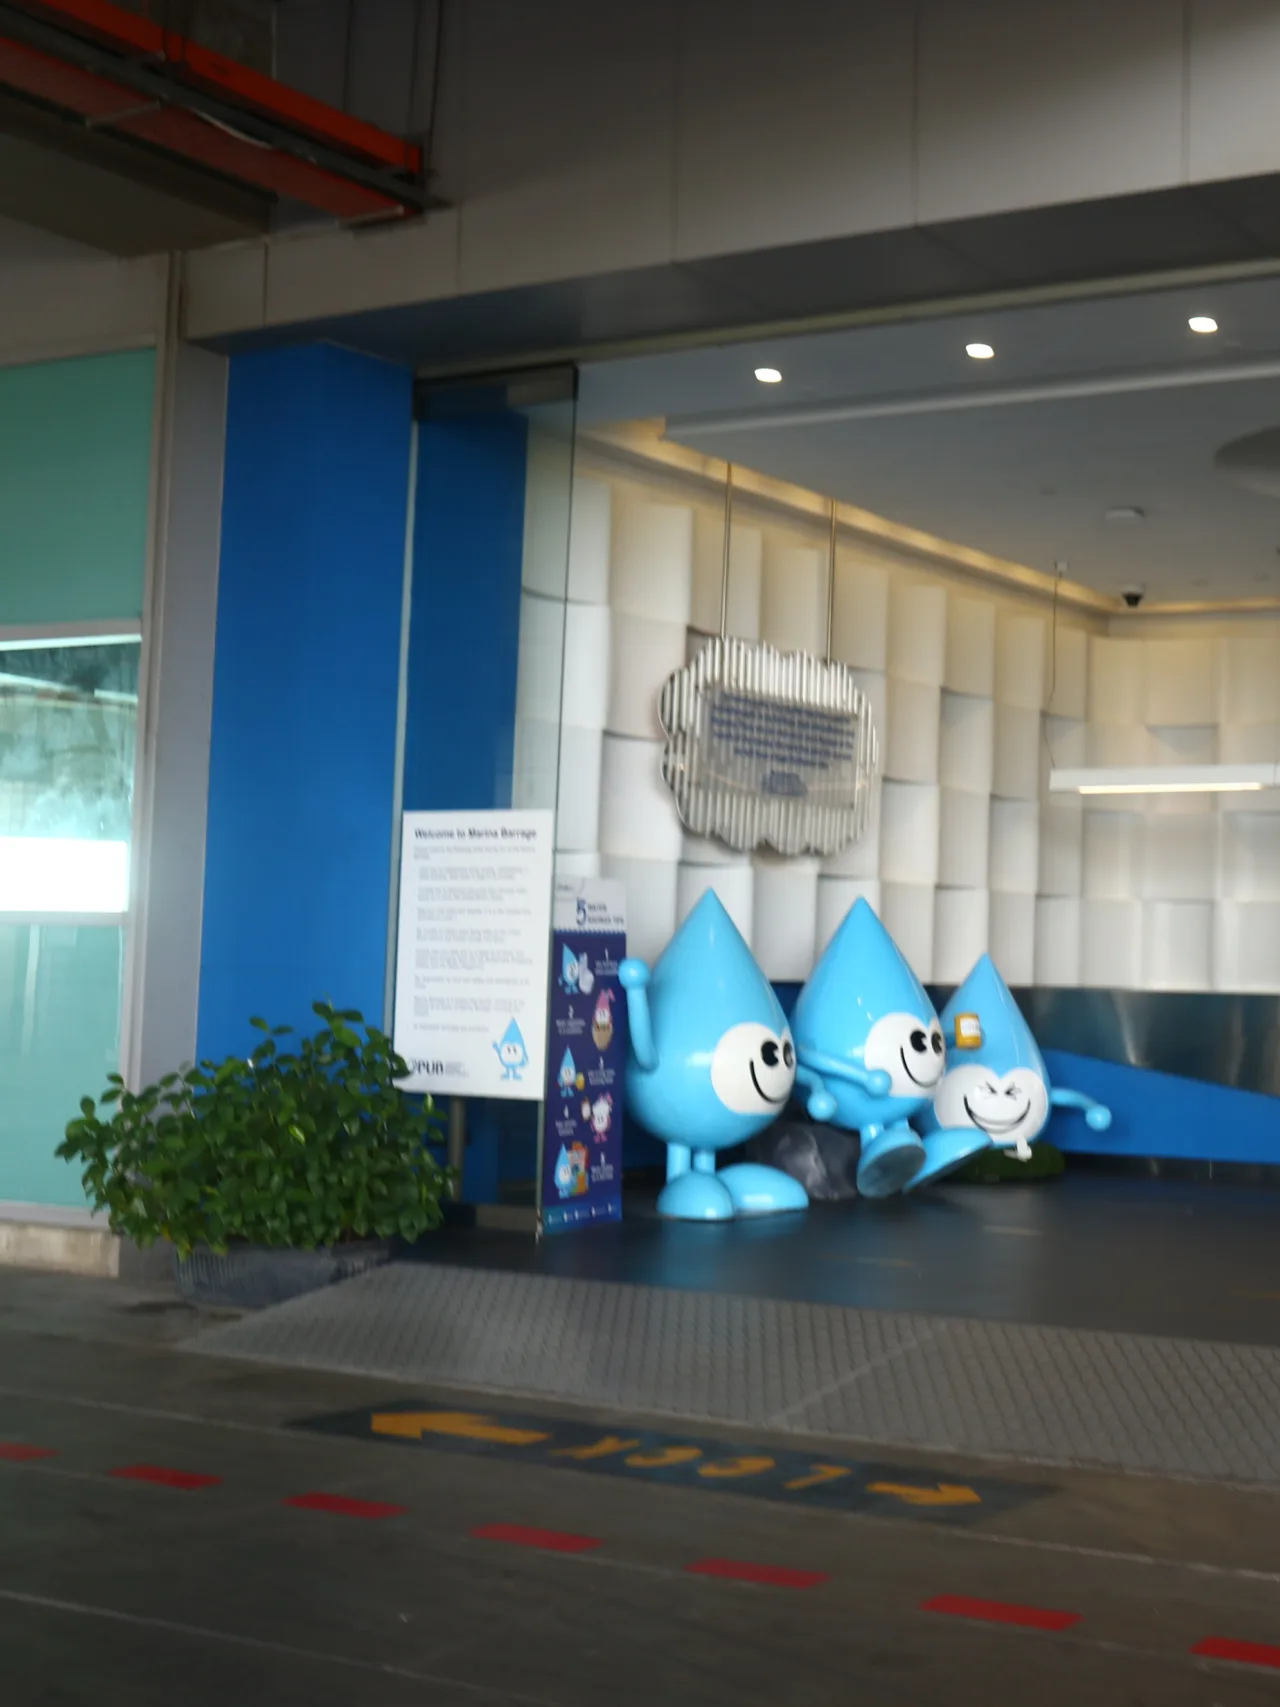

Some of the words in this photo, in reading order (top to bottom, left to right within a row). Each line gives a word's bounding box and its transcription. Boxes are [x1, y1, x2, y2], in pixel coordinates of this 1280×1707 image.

[414, 827, 455, 839] Welcome
[456, 828, 466, 839] to
[468, 826, 499, 838] Marina
[501, 826, 537, 841] Barrage
[576, 898, 587, 926] 5
[551, 1436, 851, 1490] LOOK
